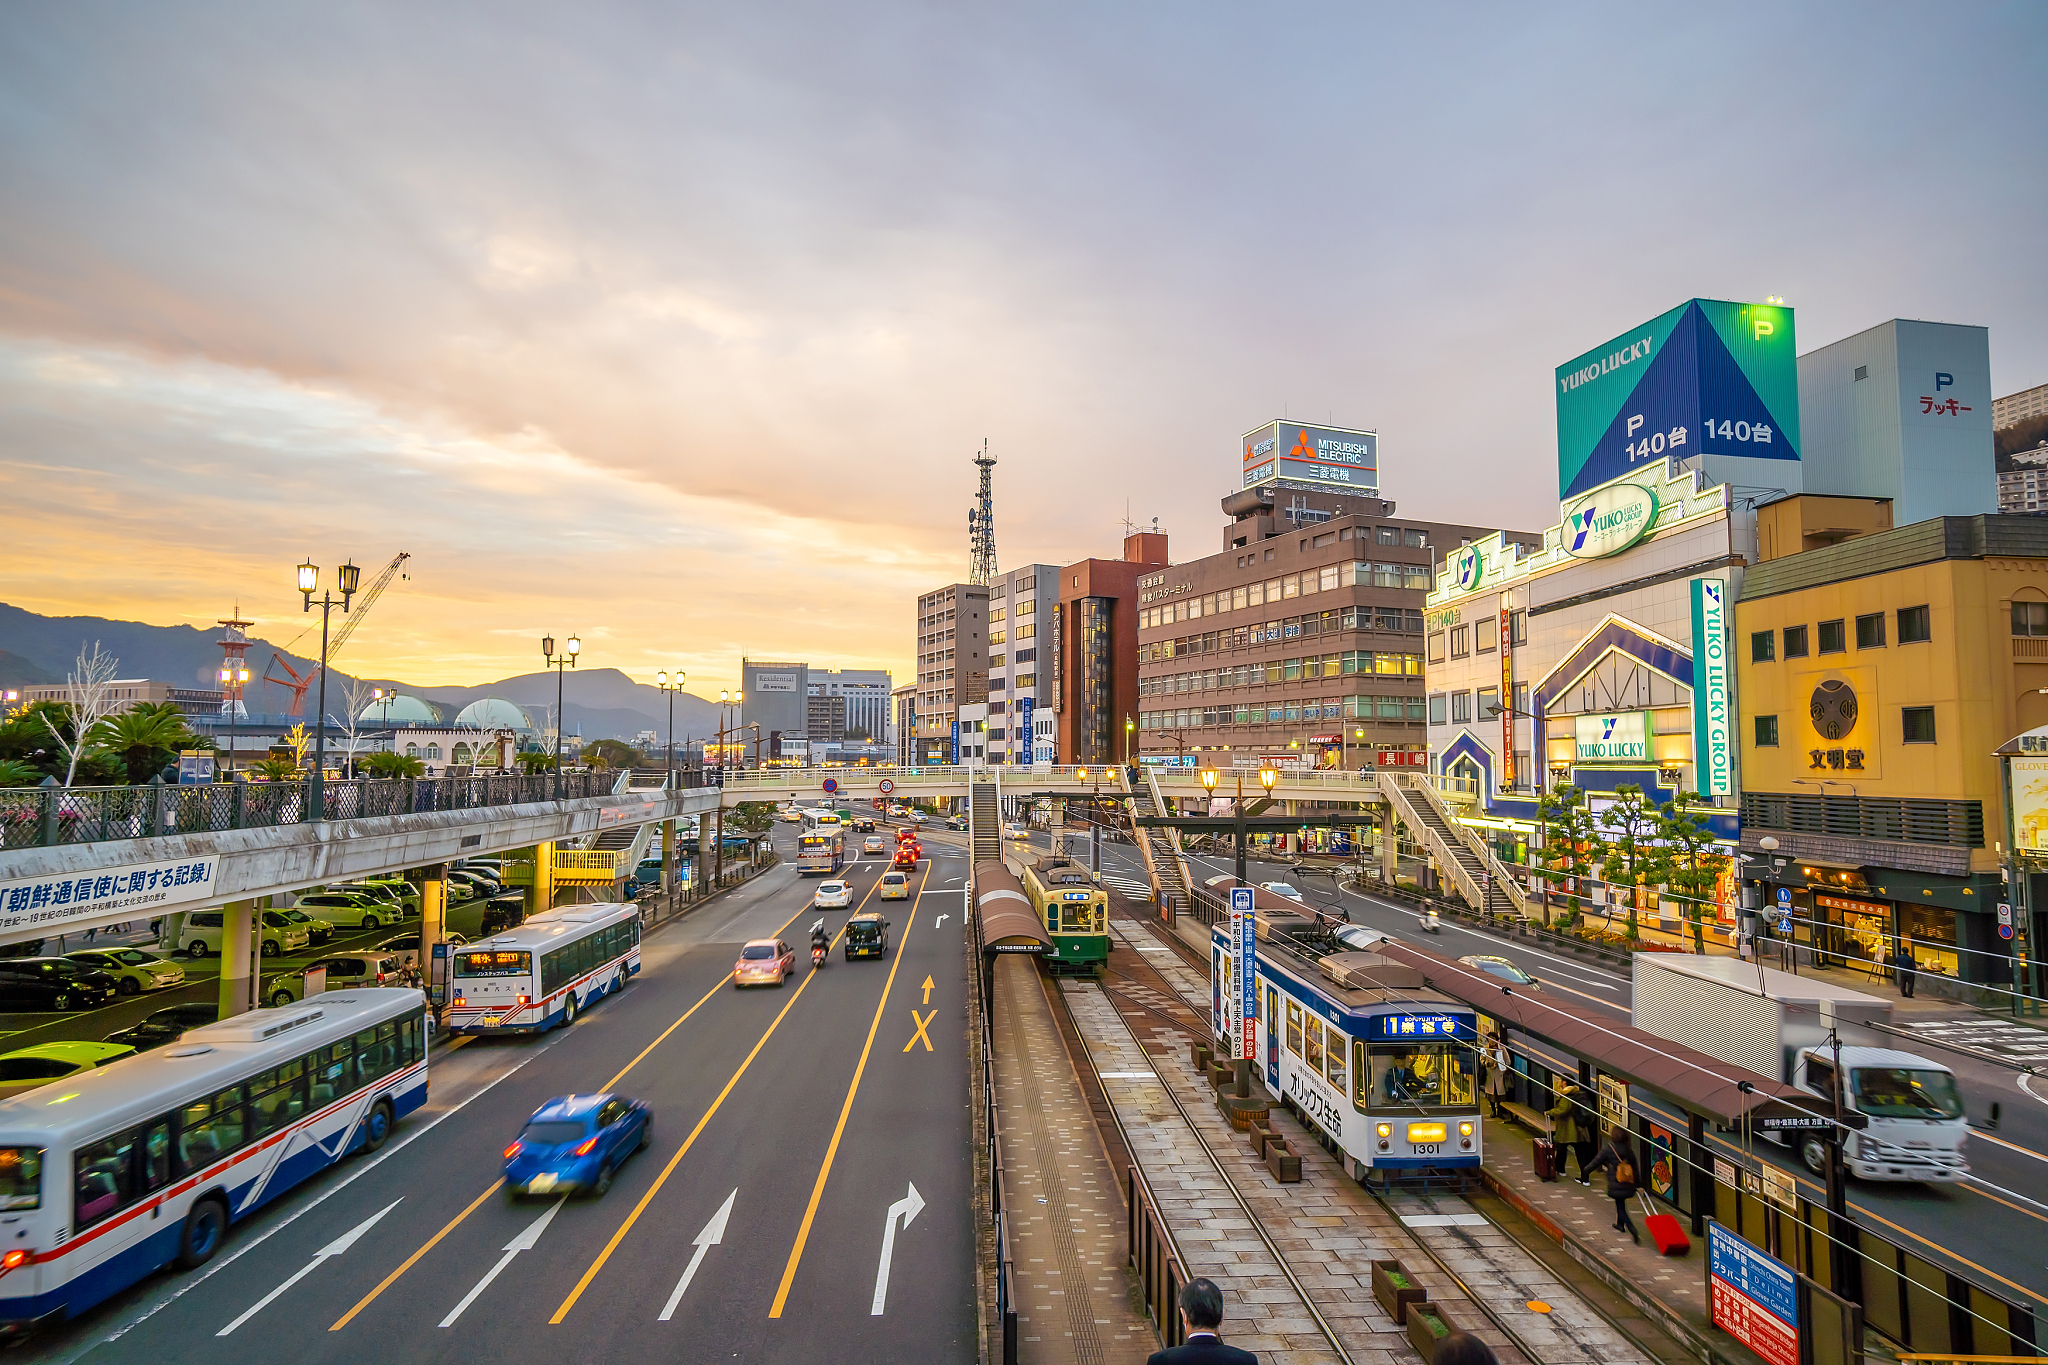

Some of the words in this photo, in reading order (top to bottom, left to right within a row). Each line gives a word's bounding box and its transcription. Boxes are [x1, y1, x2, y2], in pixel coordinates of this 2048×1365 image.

[1754, 320, 1773, 341] P
[1560, 360, 1600, 394] YUKO
[1601, 336, 1653, 376] LUCKY
[1935, 372, 1954, 392] P
[1919, 395, 1972, 417] ラッキー
[1627, 413, 1645, 438] P
[1703, 418, 1773, 445] 140台
[1318, 438, 1368, 455] MITSUBISHI
[1625, 425, 1689, 463] 140台
[1318, 449, 1362, 464] ELECTRIC
[1246, 464, 1274, 484] 三菱電機
[1309, 464, 1350, 482] 三菱電機
[1593, 509, 1624, 533] YUKO
[1624, 502, 1643, 515] LUCKY
[1624, 510, 1643, 523] GROUP
[1706, 606, 1722, 660] YUKO
[759, 674, 794, 682] Residential
[1709, 665, 1725, 724] LUCKY
[1578, 743, 1606, 758] YUKO
[1608, 742, 1644, 757] LUCKY
[1711, 728, 1727, 792] GROUP
[1808, 748, 1865, 769] 文明堂
[882, 782, 891, 790] 50
[0, 862, 212, 913] 「朝鮮通信使に関する記録」
[1389, 1017, 1398, 1034] 1
[1401, 1021, 1456, 1034] 崇福寺
[1233, 1036, 1242, 1057] のりば
[1290, 1072, 1342, 1138] オリックス生命
[1413, 1144, 1440, 1154] 1301
[1712, 1236, 1748, 1266] 新地中華街
[1713, 1260, 1749, 1291] グラバー園
[1765, 1271, 1779, 1286] China
[1714, 1286, 1750, 1319] めがね橋
